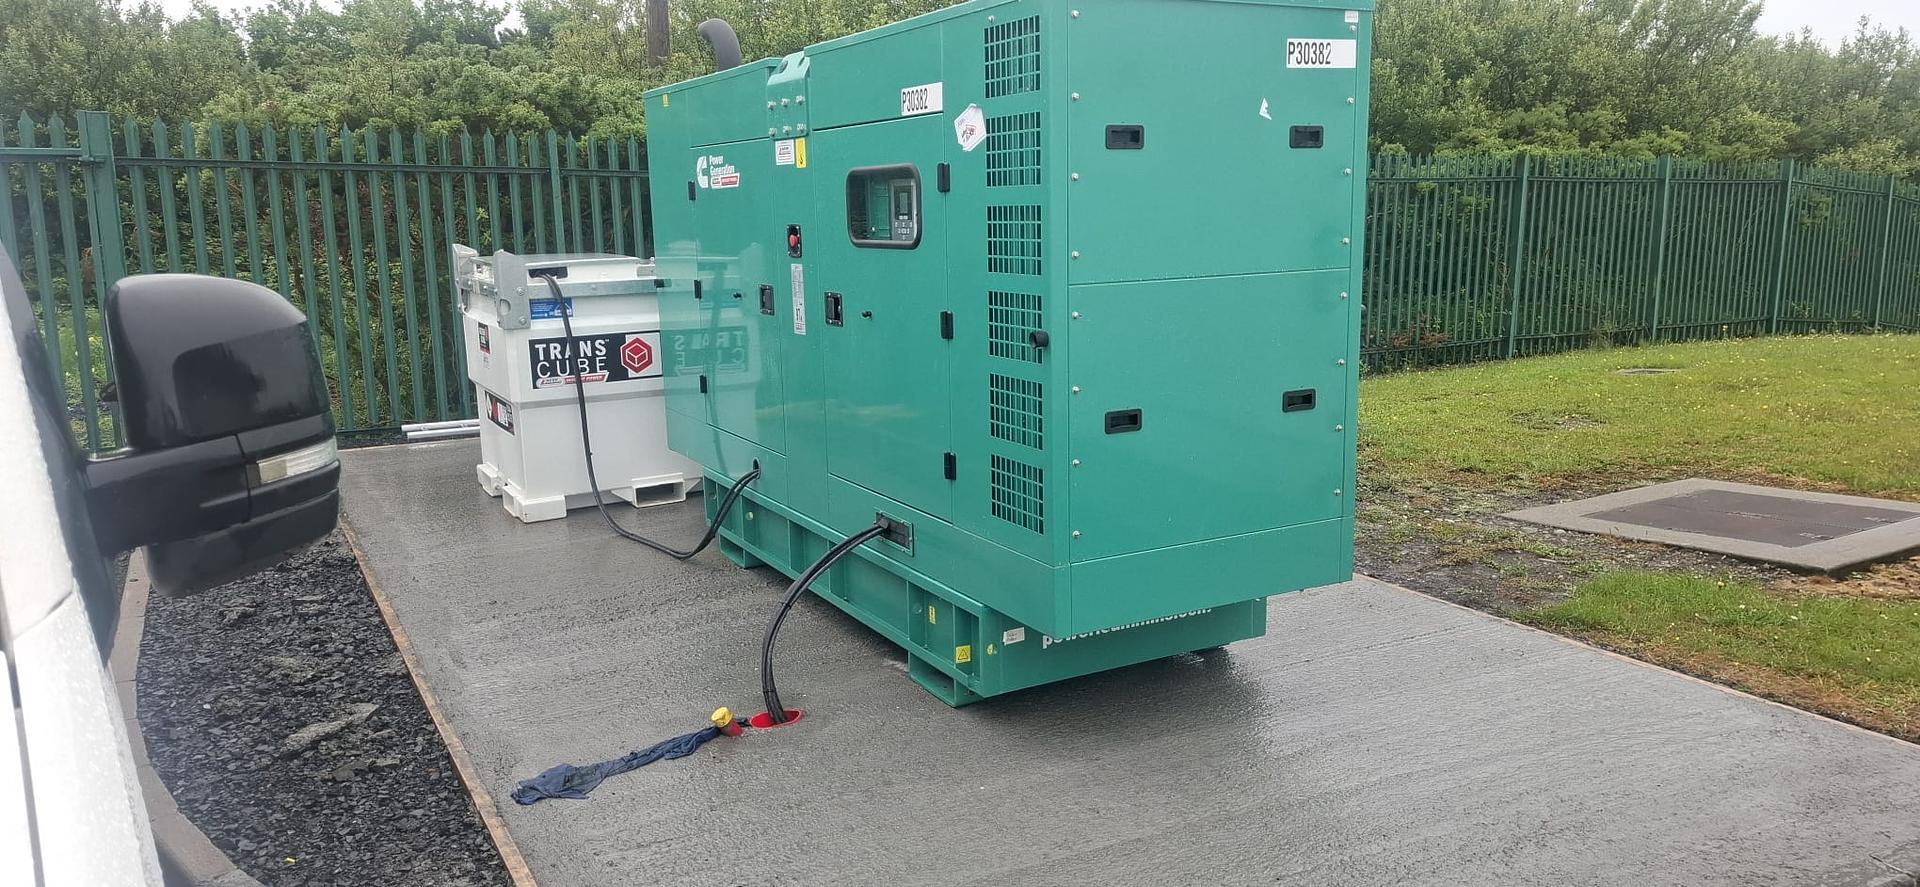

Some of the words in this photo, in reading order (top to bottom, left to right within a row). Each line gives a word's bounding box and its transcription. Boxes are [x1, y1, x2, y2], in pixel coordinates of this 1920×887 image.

[1288, 41, 1332, 65] P30382
[902, 88, 928, 113] P30382
[709, 155, 724, 165] Power
[710, 164, 735, 176] Generation
[537, 357, 608, 378] CUBE
